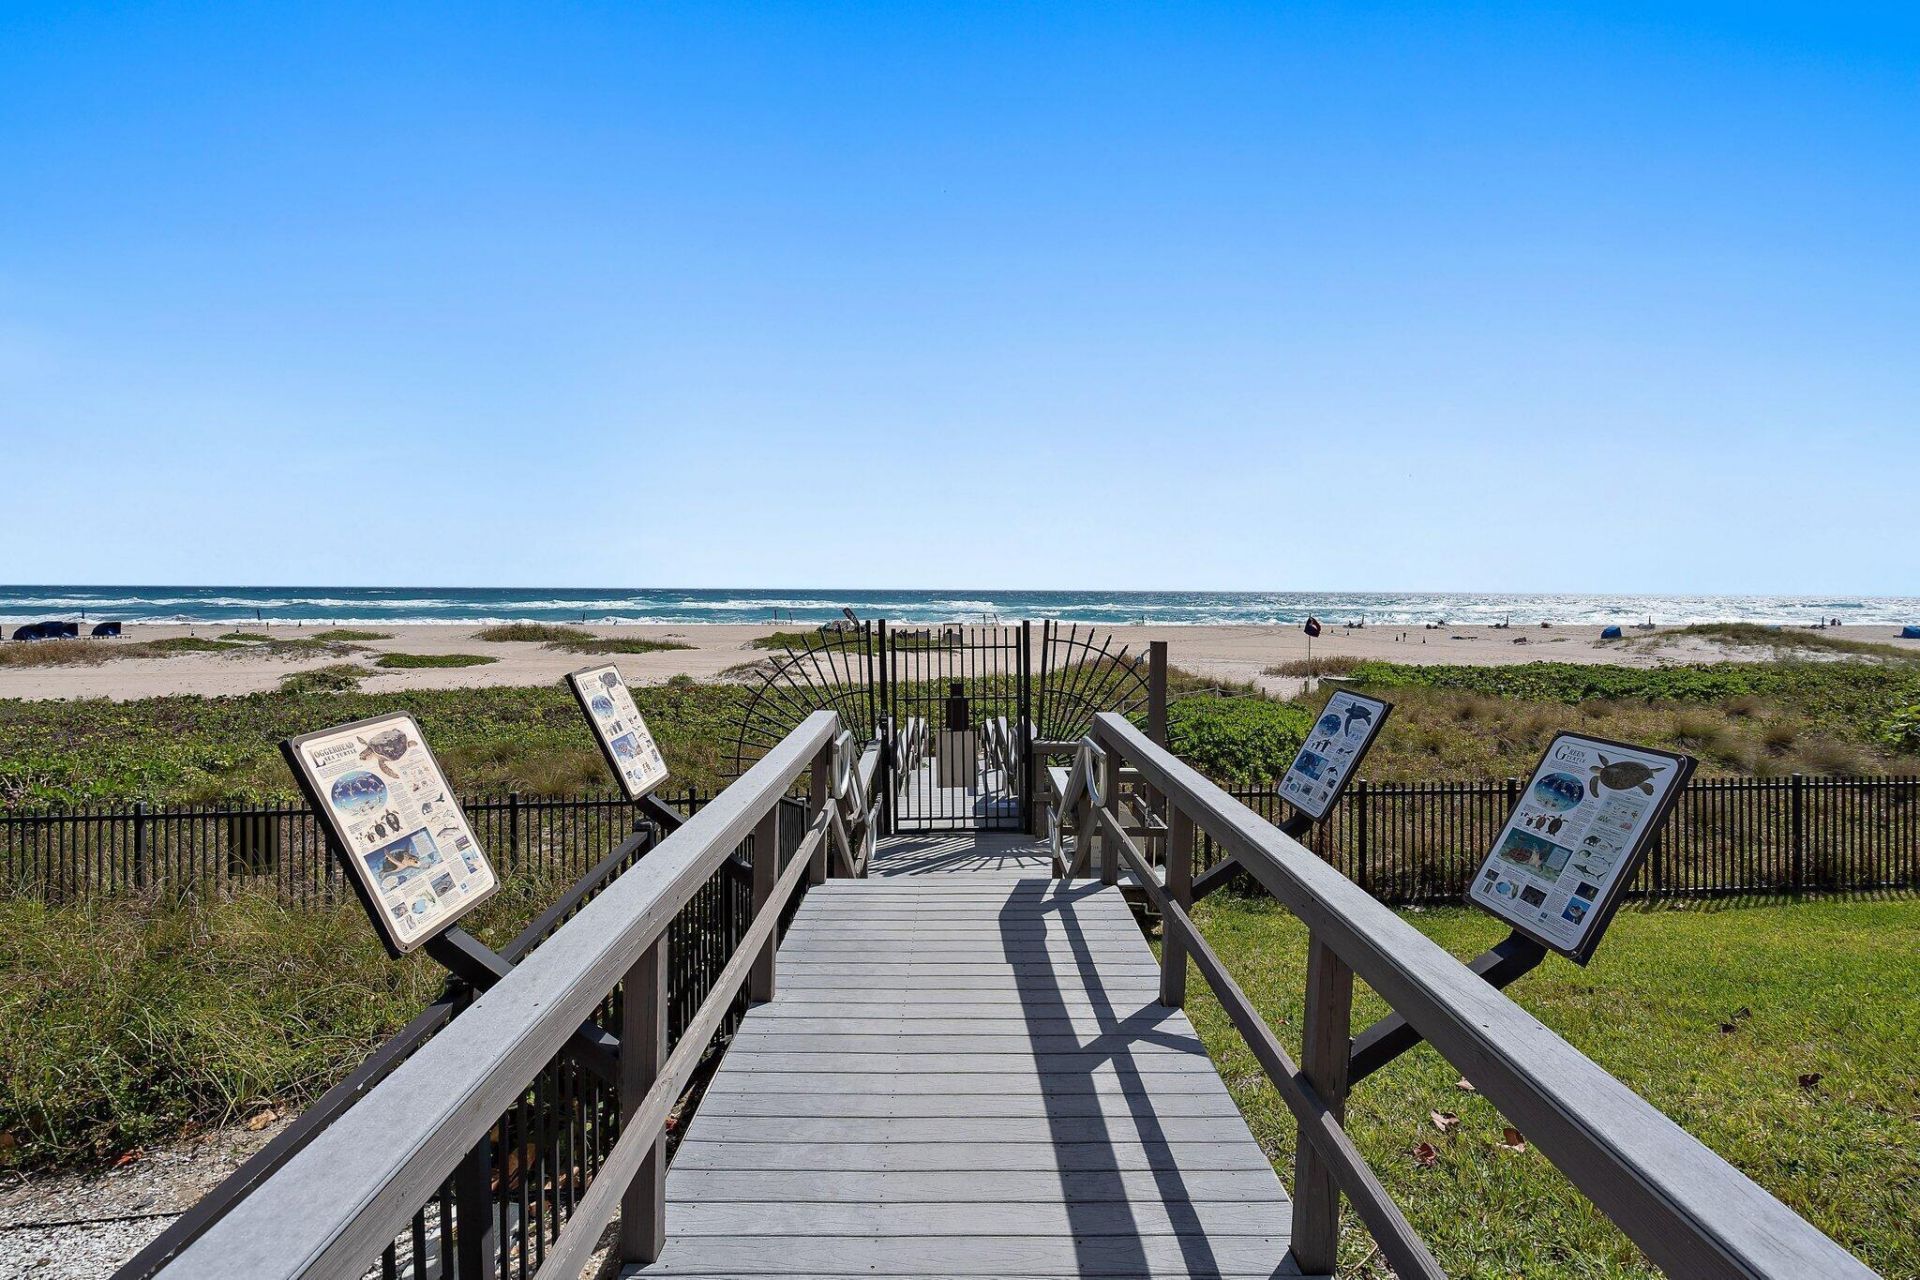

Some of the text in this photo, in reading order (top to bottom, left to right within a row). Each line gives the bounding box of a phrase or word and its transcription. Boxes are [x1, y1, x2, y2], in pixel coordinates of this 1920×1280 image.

[308, 742, 354, 768] LOGGERHEAD
[335, 749, 357, 758] TURTLE
[1555, 745, 1584, 760] GREEN
